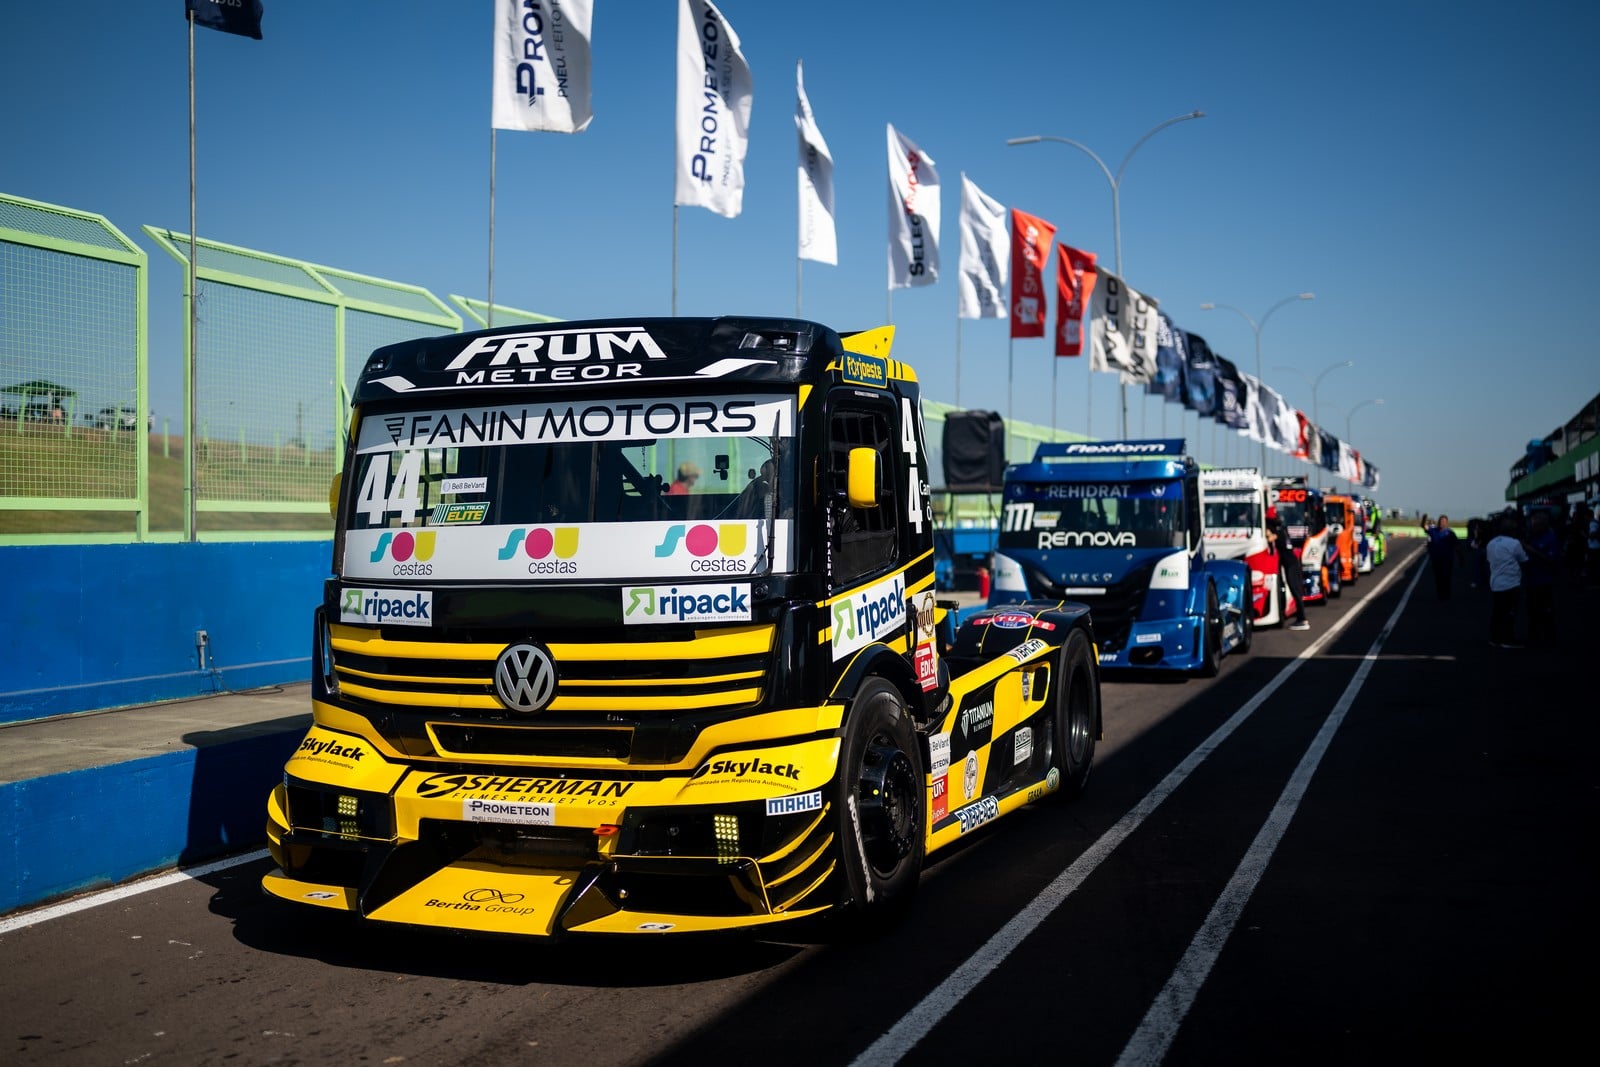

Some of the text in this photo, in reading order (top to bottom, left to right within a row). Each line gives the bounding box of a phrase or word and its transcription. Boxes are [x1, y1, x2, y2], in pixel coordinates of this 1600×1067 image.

[444, 327, 668, 370] FRUM
[456, 363, 642, 384] METEOR
[410, 401, 756, 445] FANIN MOTORS
[1066, 443, 1165, 454] Flexform
[356, 449, 421, 524] 44
[1049, 485, 1131, 498] REHIDRAT
[446, 511, 484, 521] ELITE
[392, 562, 432, 576] cestas
[528, 559, 577, 574] cestas
[691, 557, 746, 572] cestas
[1061, 572, 1113, 582] IVECO
[364, 591, 430, 622] ripack
[659, 586, 748, 620] ripack
[856, 579, 905, 640] ripack
[968, 700, 994, 725] TITANIUM
[300, 737, 365, 761] Skylack
[711, 758, 800, 780] Skylack
[932, 758, 949, 770] ETEON
[452, 792, 509, 801] FILMES
[462, 775, 635, 798] SHERMAN
[469, 800, 550, 817] PROMETEON
[768, 793, 821, 814] MAHLE
[424, 898, 535, 916] Bertha Group
